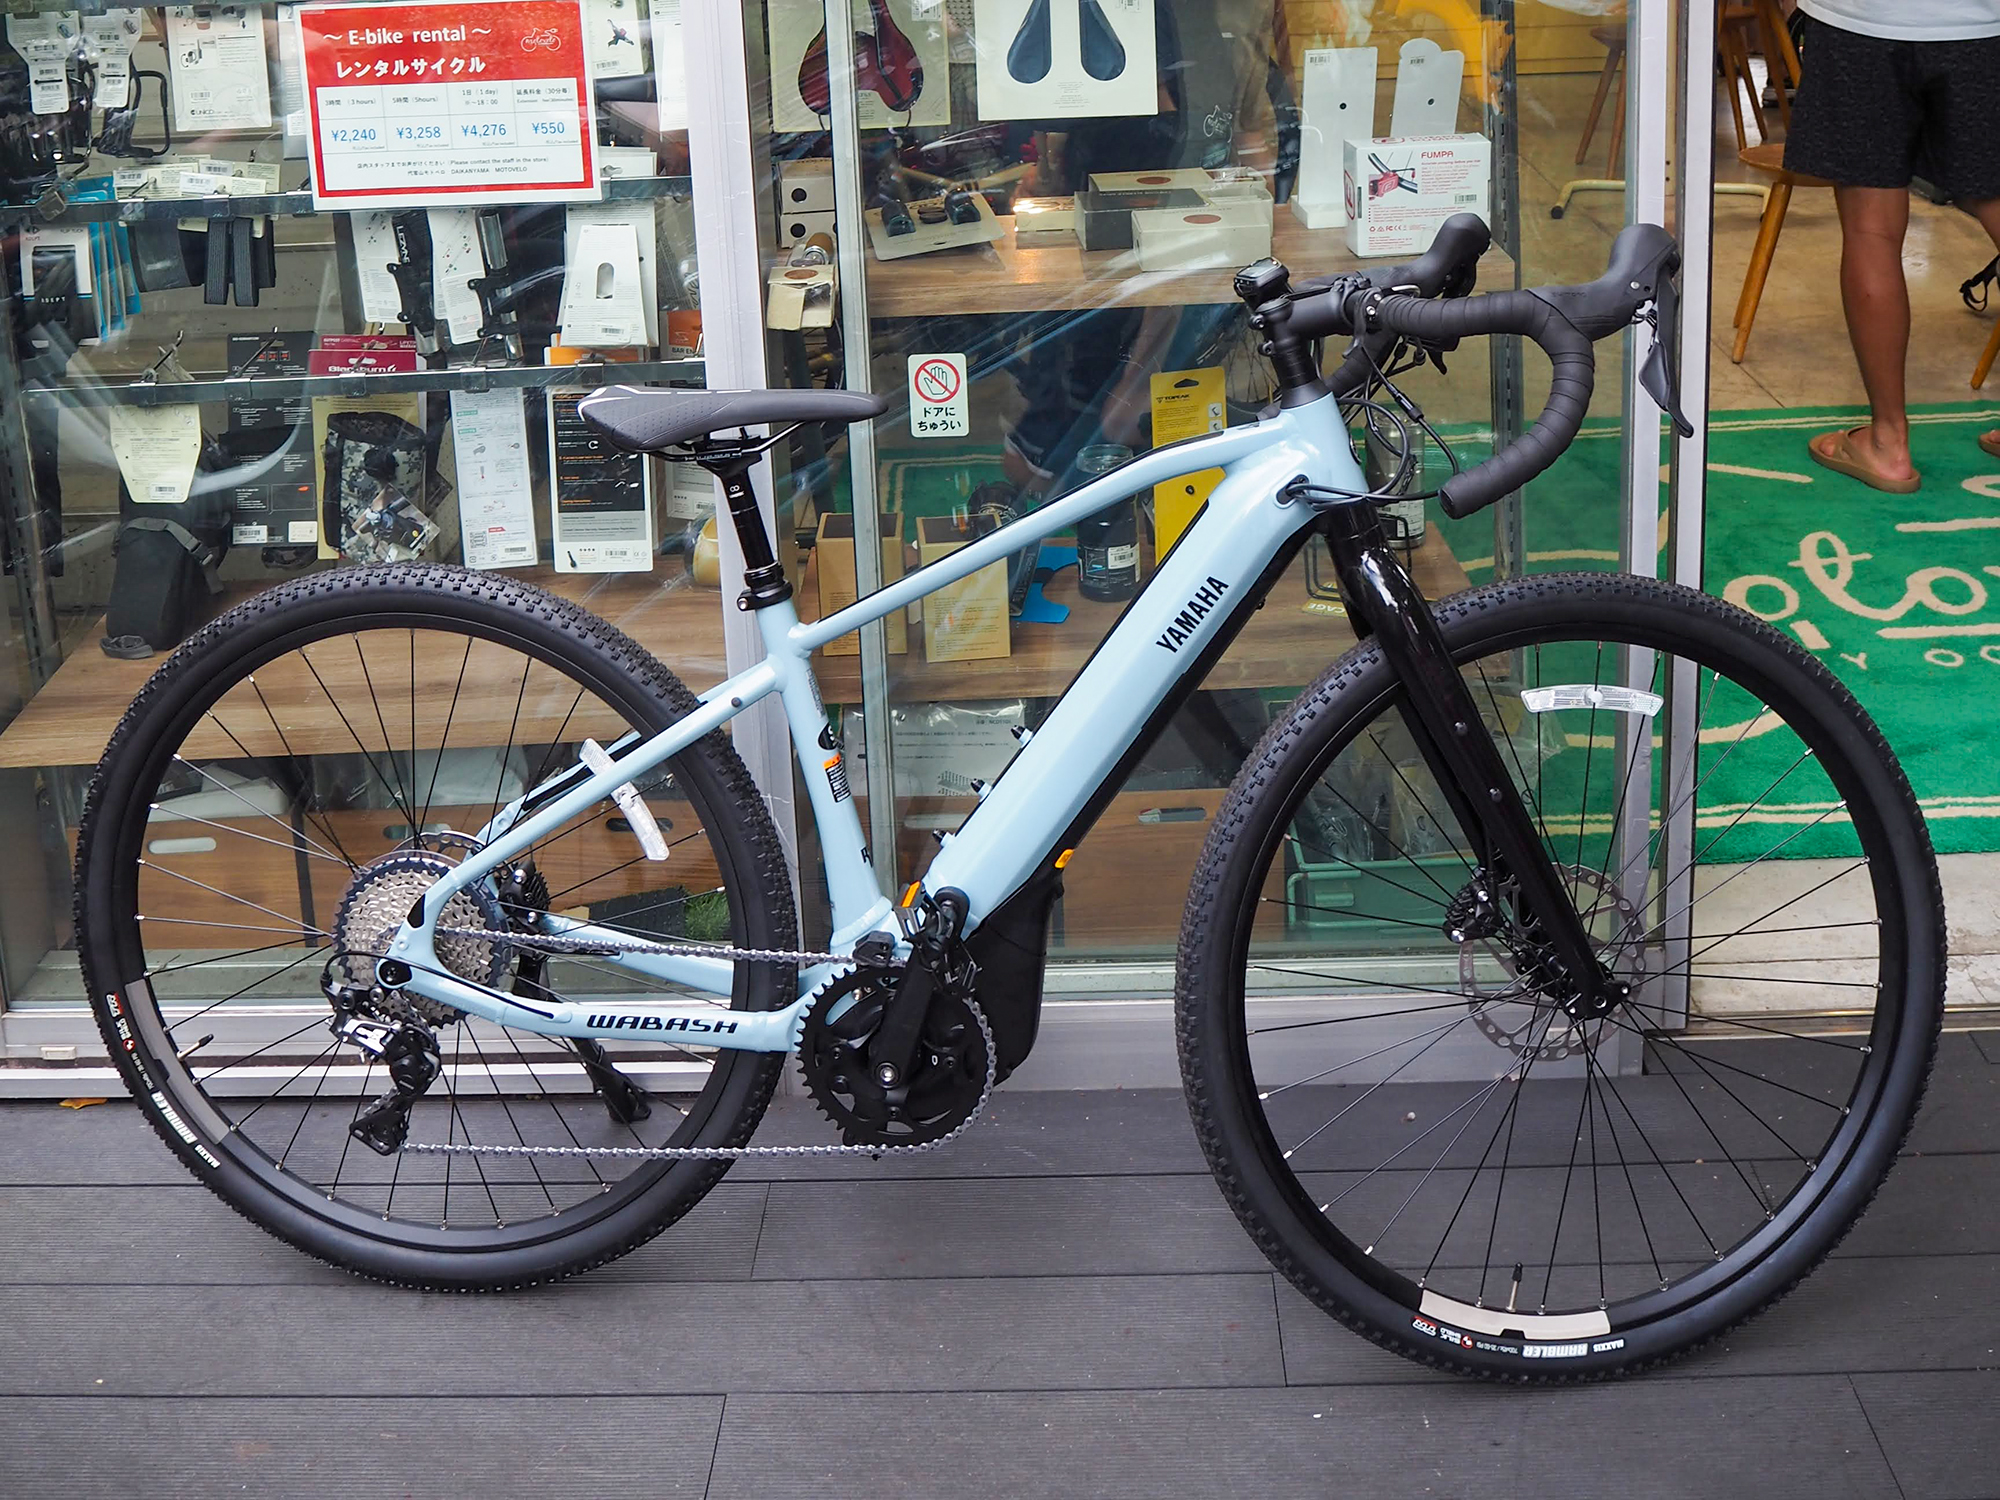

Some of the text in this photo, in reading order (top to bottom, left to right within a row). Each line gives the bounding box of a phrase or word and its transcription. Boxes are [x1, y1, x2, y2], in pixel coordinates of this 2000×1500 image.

[349, 29, 403, 46] E-bike
[413, 25, 466, 43] rental
[336, 56, 486, 79] レンタルサイクル
[331, 128, 377, 143] ¥2,240
[396, 126, 442, 140] ¥3,258
[461, 123, 507, 139] ¥4,276
[531, 121, 566, 135] ¥550
[1421, 150, 1454, 159] FUMPA
[923, 406, 956, 417] ドアに
[917, 419, 962, 432] ちゅうい
[1156, 576, 1229, 653] YAMAHA
[586, 1014, 738, 1034] WABASH
[150, 1089, 198, 1145] RAMBLER
[194, 1144, 221, 1169] MAXXIS
[1522, 1342, 1588, 1358] RAMBLER
[1593, 1339, 1625, 1353] MAXXIS
